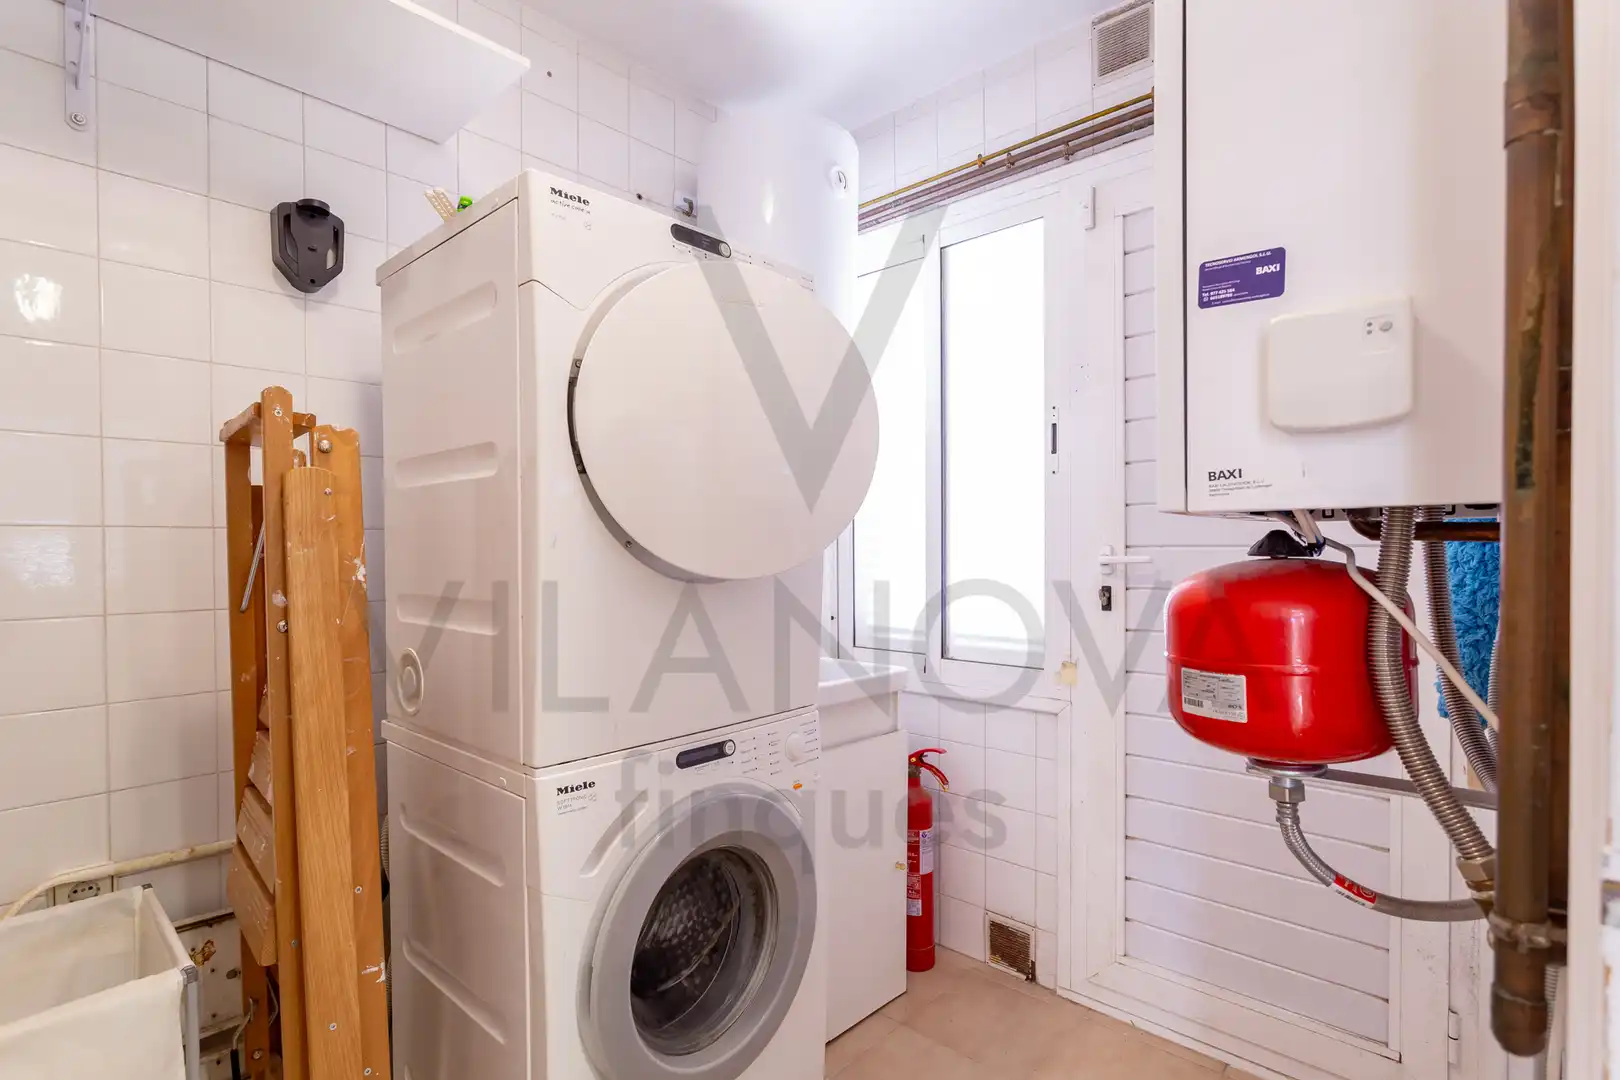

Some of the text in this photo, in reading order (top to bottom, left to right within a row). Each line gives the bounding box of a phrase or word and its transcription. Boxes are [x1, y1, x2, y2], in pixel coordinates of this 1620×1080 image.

[549, 186, 590, 205] Miele
[1256, 263, 1280, 275] BAXI
[1208, 468, 1242, 482] BAXI
[556, 781, 596, 796] Miele
